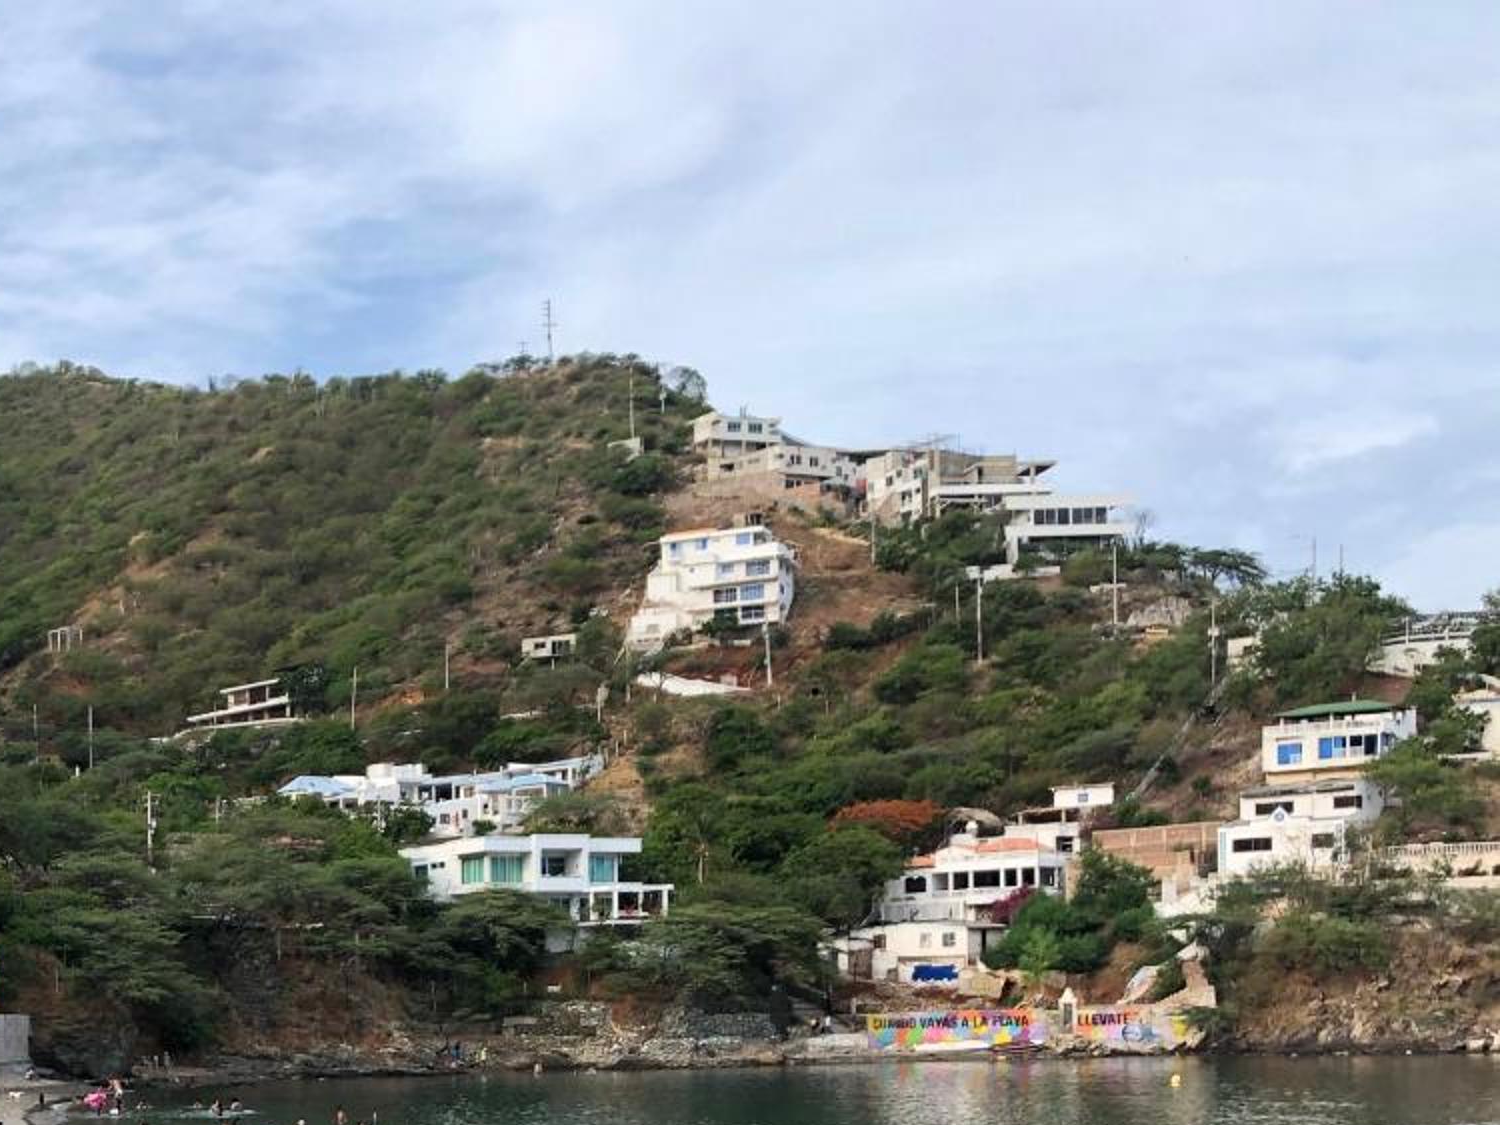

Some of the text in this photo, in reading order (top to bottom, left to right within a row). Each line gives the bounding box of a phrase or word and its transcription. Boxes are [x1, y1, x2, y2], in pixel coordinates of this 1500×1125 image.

[873, 1015, 1029, 1030] CUANDO VAYAS A LA PLAYA
[1077, 1013, 1128, 1026] LLEVATE
